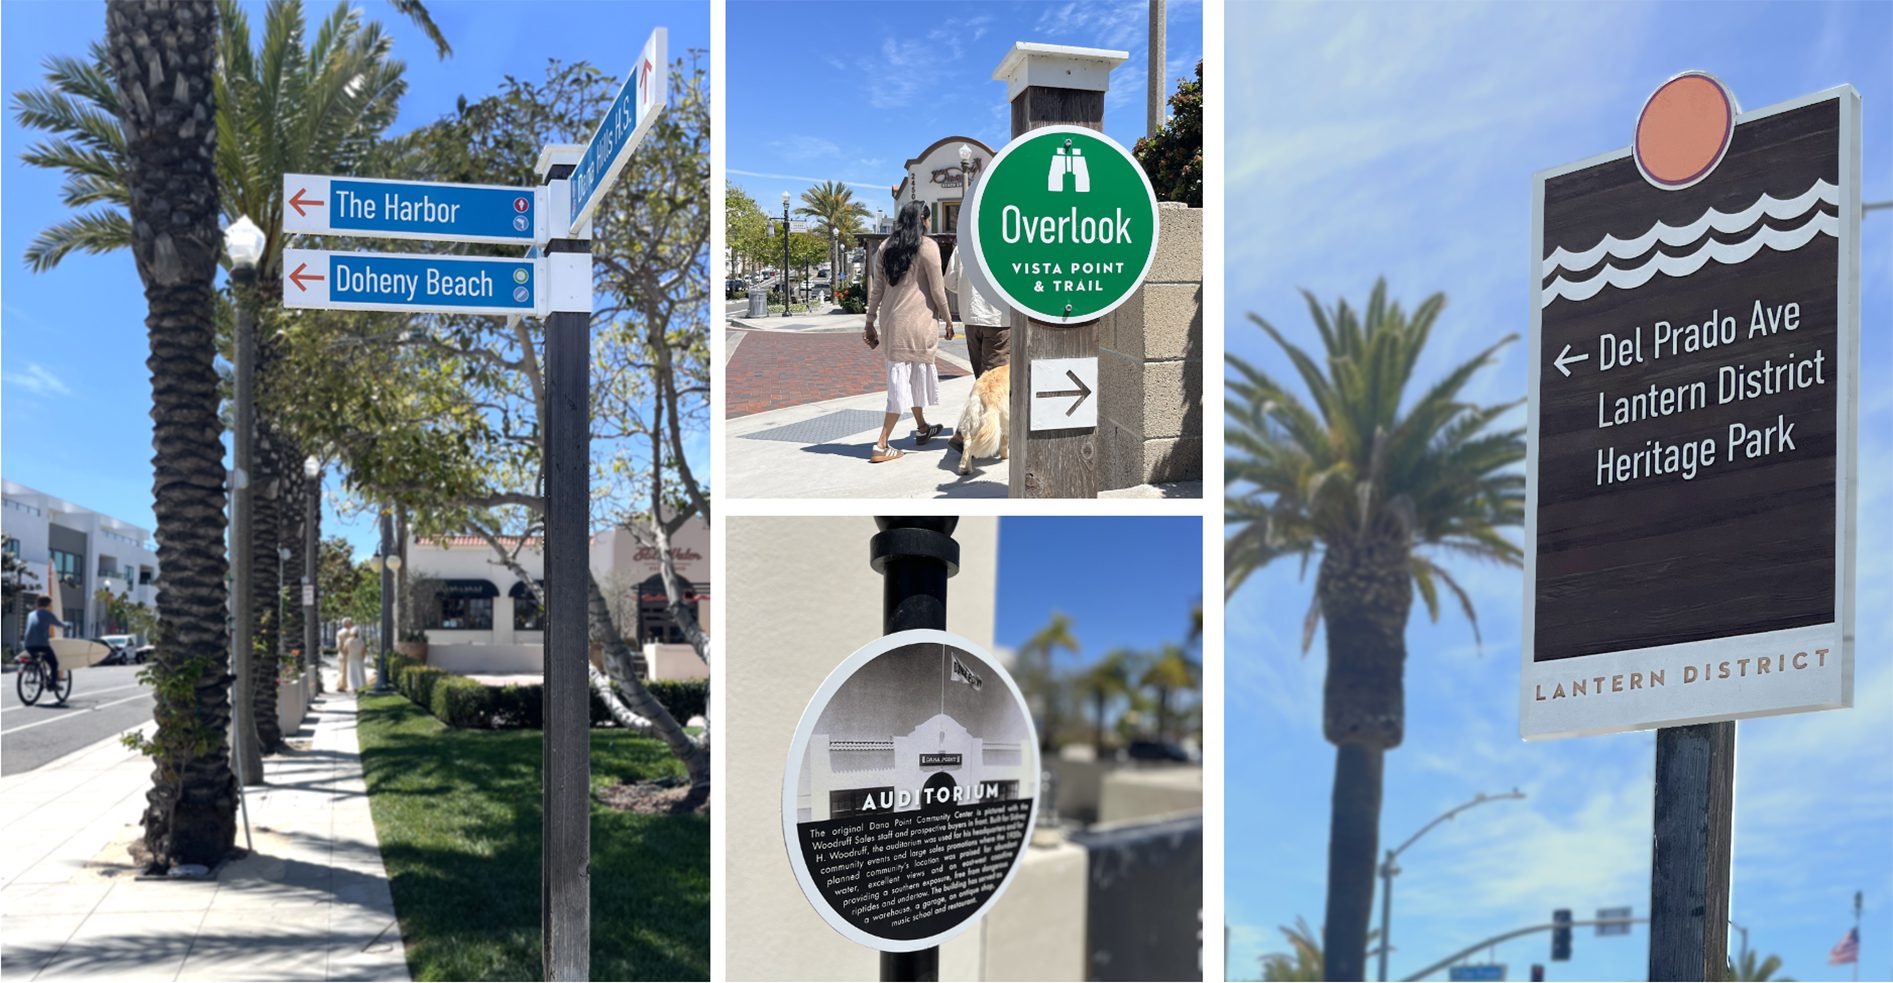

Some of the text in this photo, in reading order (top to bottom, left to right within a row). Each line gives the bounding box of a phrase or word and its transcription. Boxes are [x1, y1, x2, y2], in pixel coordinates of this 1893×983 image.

[577, 95, 632, 203] Dana Hills H.S.
[336, 190, 460, 224] The Harbor
[1002, 204, 1132, 244] Overlook
[336, 264, 493, 302] Doheny Beach
[1012, 262, 1124, 274] VISTA POINT
[1034, 280, 1103, 292] & TRAIL
[1600, 300, 1800, 371] Del Prado Ave
[1599, 350, 1825, 428] Lantern District
[1597, 414, 1796, 486] Heritage Park
[1536, 648, 1830, 701] LANTERN DISTRICT
[862, 783, 999, 811] AUDITORIUM
[810, 829, 826, 838] The
[832, 822, 864, 836] original
[869, 822, 890, 831] Dana
[894, 818, 912, 827] Point
[916, 812, 951, 824] Community
[954, 810, 973, 819] Center
[812, 836, 852, 850] Woodruff
[855, 834, 875, 845] Sales
[878, 830, 893, 841] staff
[895, 828, 909, 838] and
[910, 824, 947, 838] prospective
[947, 821, 967, 832] buyers
[816, 853, 826, 863] H.
[829, 845, 870, 860] Woodruff,
[872, 844, 884, 853] the
[885, 839, 922, 850] auditorium
[938, 832, 952, 842] used
[953, 831, 962, 840] for
[963, 829, 971, 838] his
[820, 860, 865, 875] community
[867, 856, 891, 866] events
[893, 850, 907, 861] and
[909, 849, 927, 858] large
[929, 844, 945, 854] sales
[946, 839, 978, 852] promotions
[827, 870, 861, 888] planned
[866, 862, 909, 878] community's
[914, 857, 940, 868] location
[834, 885, 860, 896] water,
[867, 876, 900, 889] excellent
[906, 871, 926, 880] views
[931, 864, 944, 874] and
[843, 892, 880, 909] providing
[891, 882, 920, 895] southern
[922, 875, 952, 887] exposure,
[851, 902, 880, 917] riptides
[881, 896, 896, 908] and
[897, 892, 930, 905] undertow.
[931, 886, 942, 895] The
[943, 880, 967, 892] building
[872, 906, 912, 921] warehouse,
[922, 896, 947, 910] garage,
[949, 893, 957, 901] an
[891, 915, 911, 927] music
[912, 907, 934, 921] school
[934, 903, 947, 914] and
